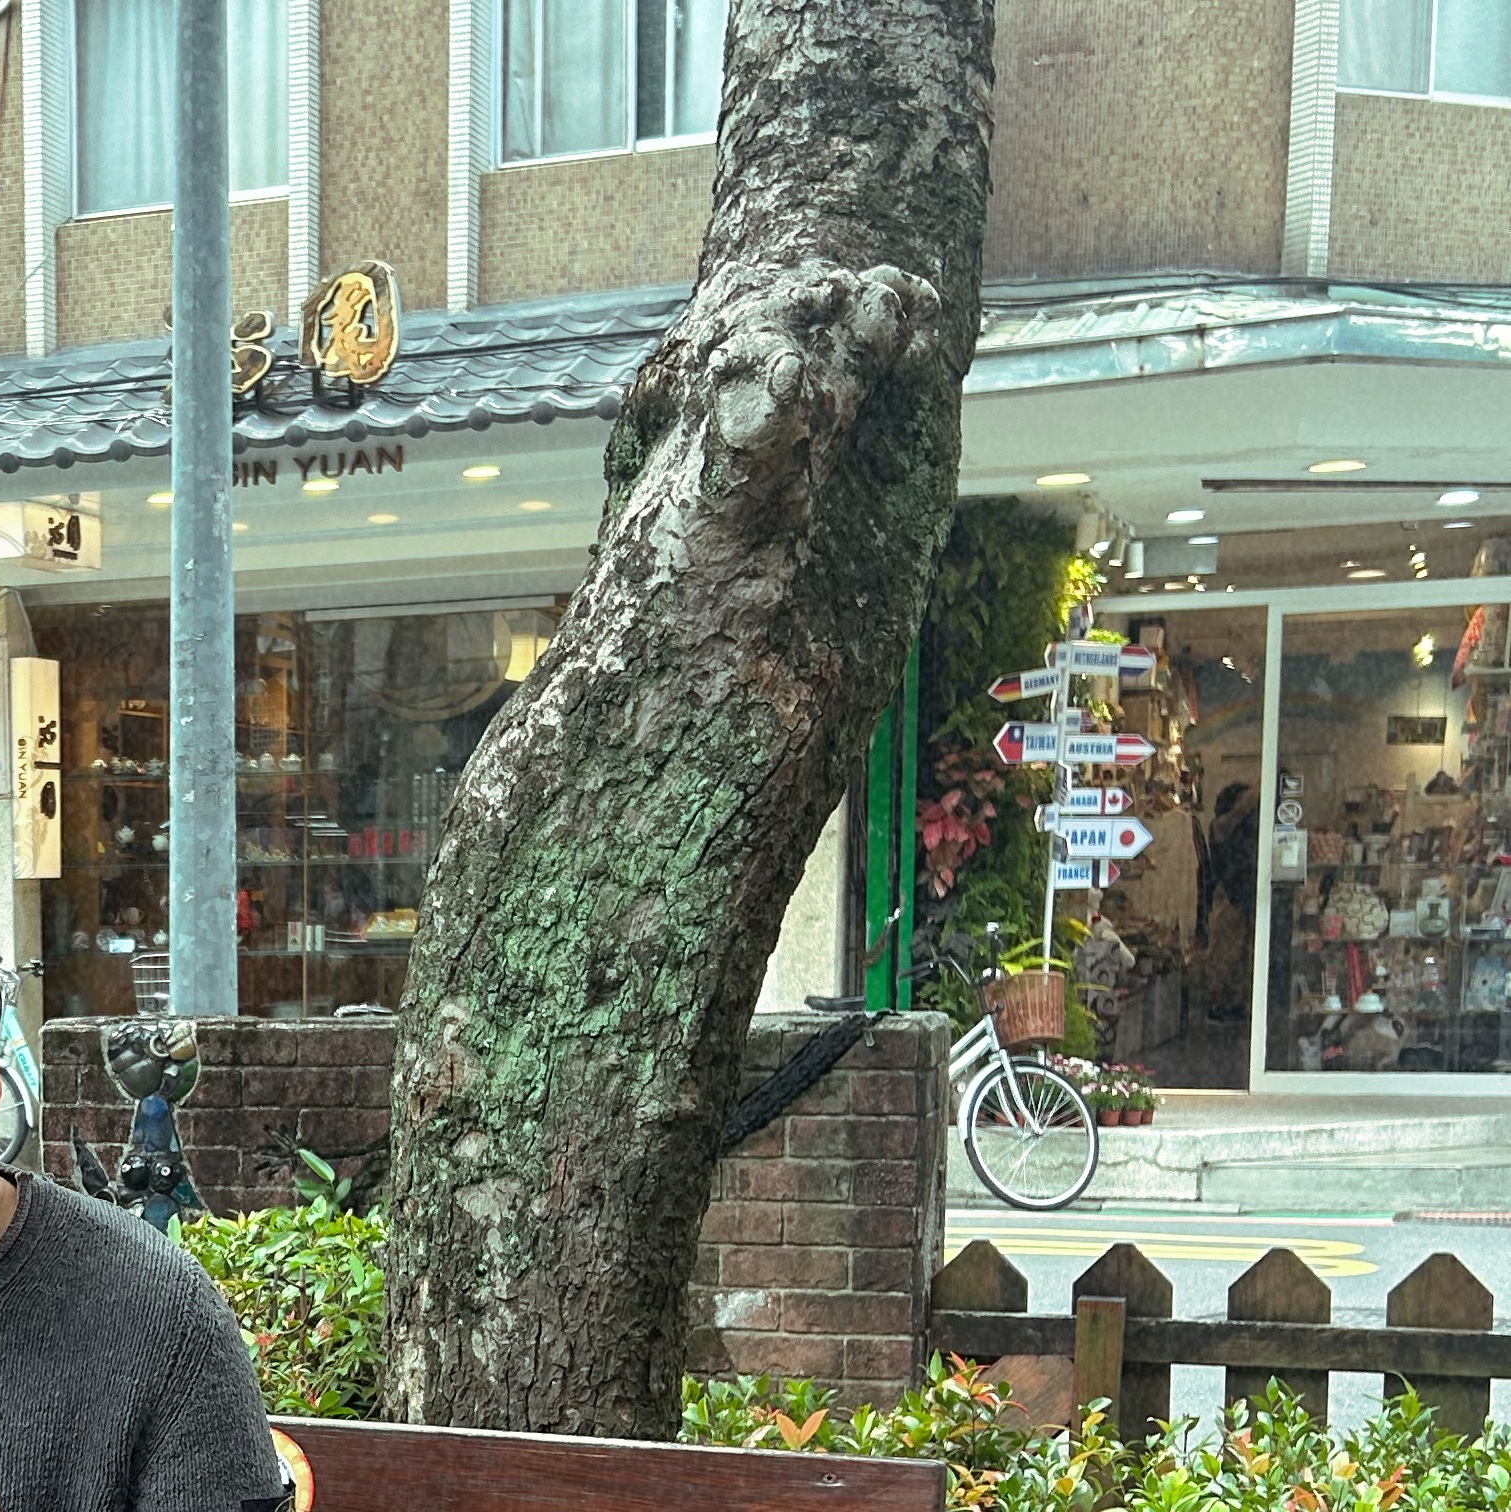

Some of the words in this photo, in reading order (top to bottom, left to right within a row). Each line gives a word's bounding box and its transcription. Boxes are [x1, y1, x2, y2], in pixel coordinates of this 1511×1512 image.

[232, 460, 278, 488] IN
[292, 444, 404, 483] YUAN
[1069, 794, 1098, 807] ANADA
